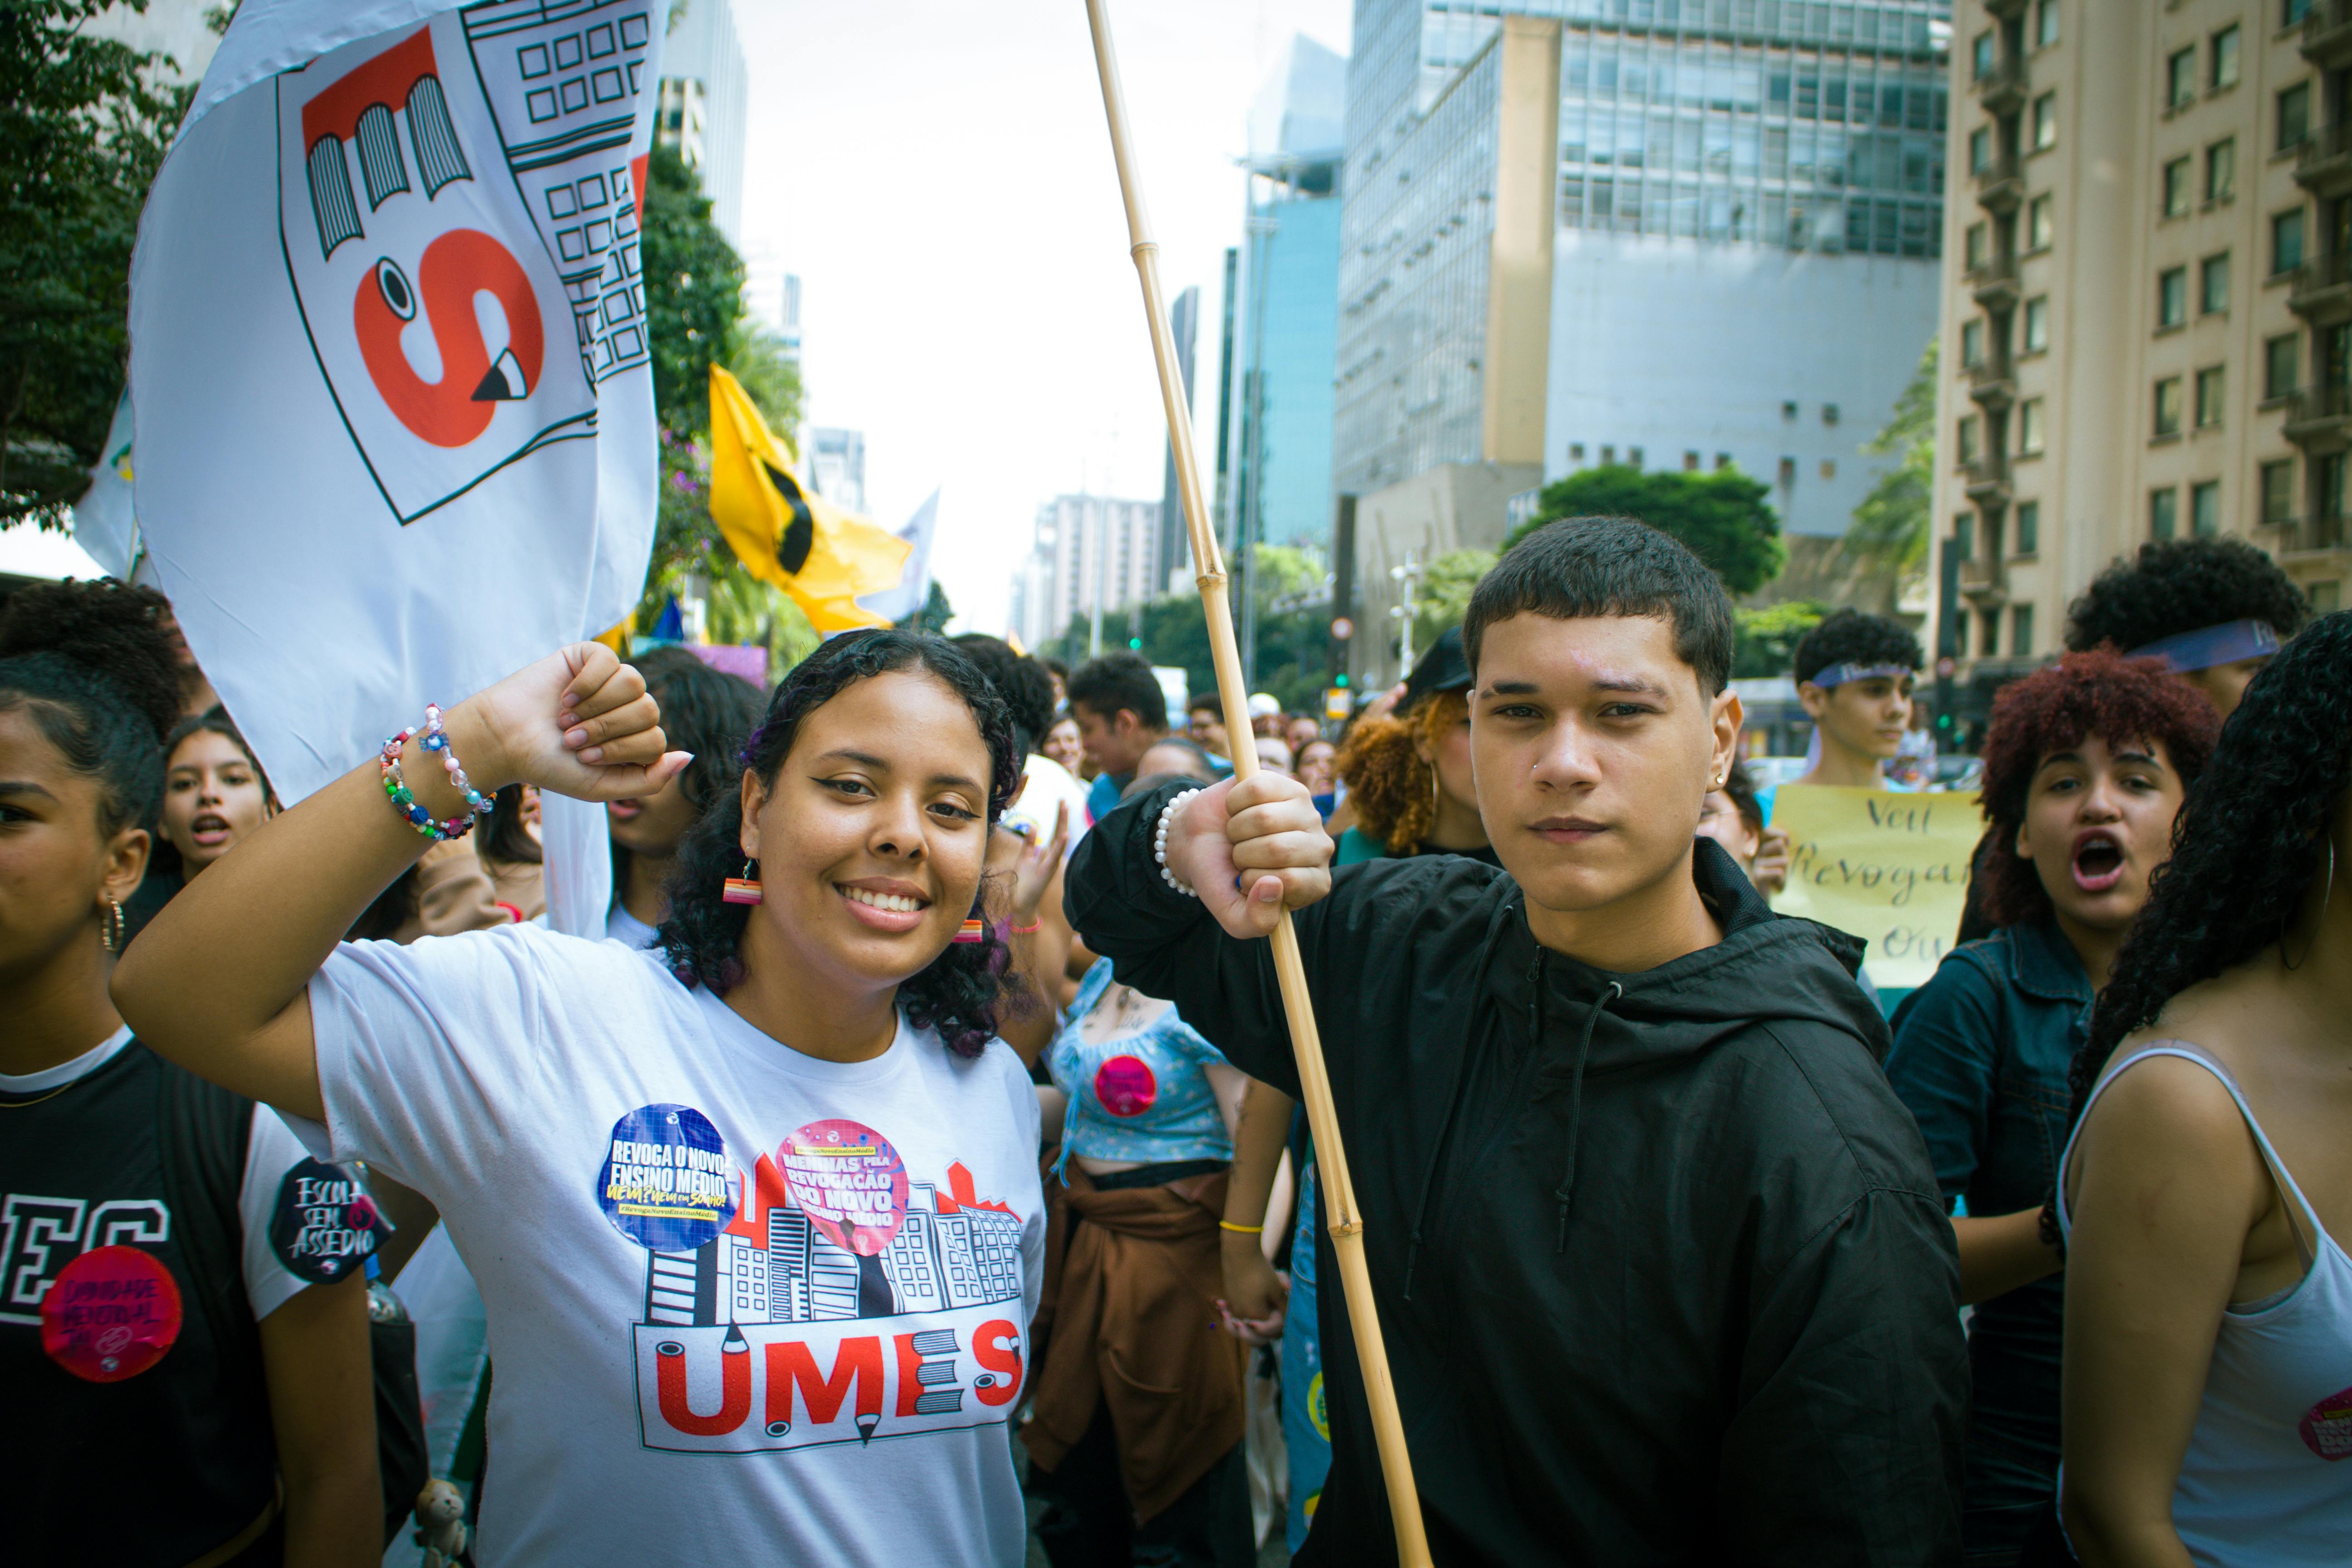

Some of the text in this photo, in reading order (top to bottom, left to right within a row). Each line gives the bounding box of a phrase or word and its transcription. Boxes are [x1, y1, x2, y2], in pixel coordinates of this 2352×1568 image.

[612, 1140, 725, 1175] REVOGA O NOVO
[783, 1154, 890, 1173] MENINAS PELA
[610, 1163, 726, 1198] ENSINO MÉDIO
[786, 1168, 892, 1190] REVOGAÇÃO
[652, 1190, 677, 1205] NEM
[791, 1182, 892, 1212] DO NOVO
[304, 1207, 343, 1230] SEM
[620, 1205, 716, 1218] #RevogaNovoEnsinoMédio
[799, 1199, 843, 1223] ENSINO
[656, 1320, 1023, 1446] UMES
